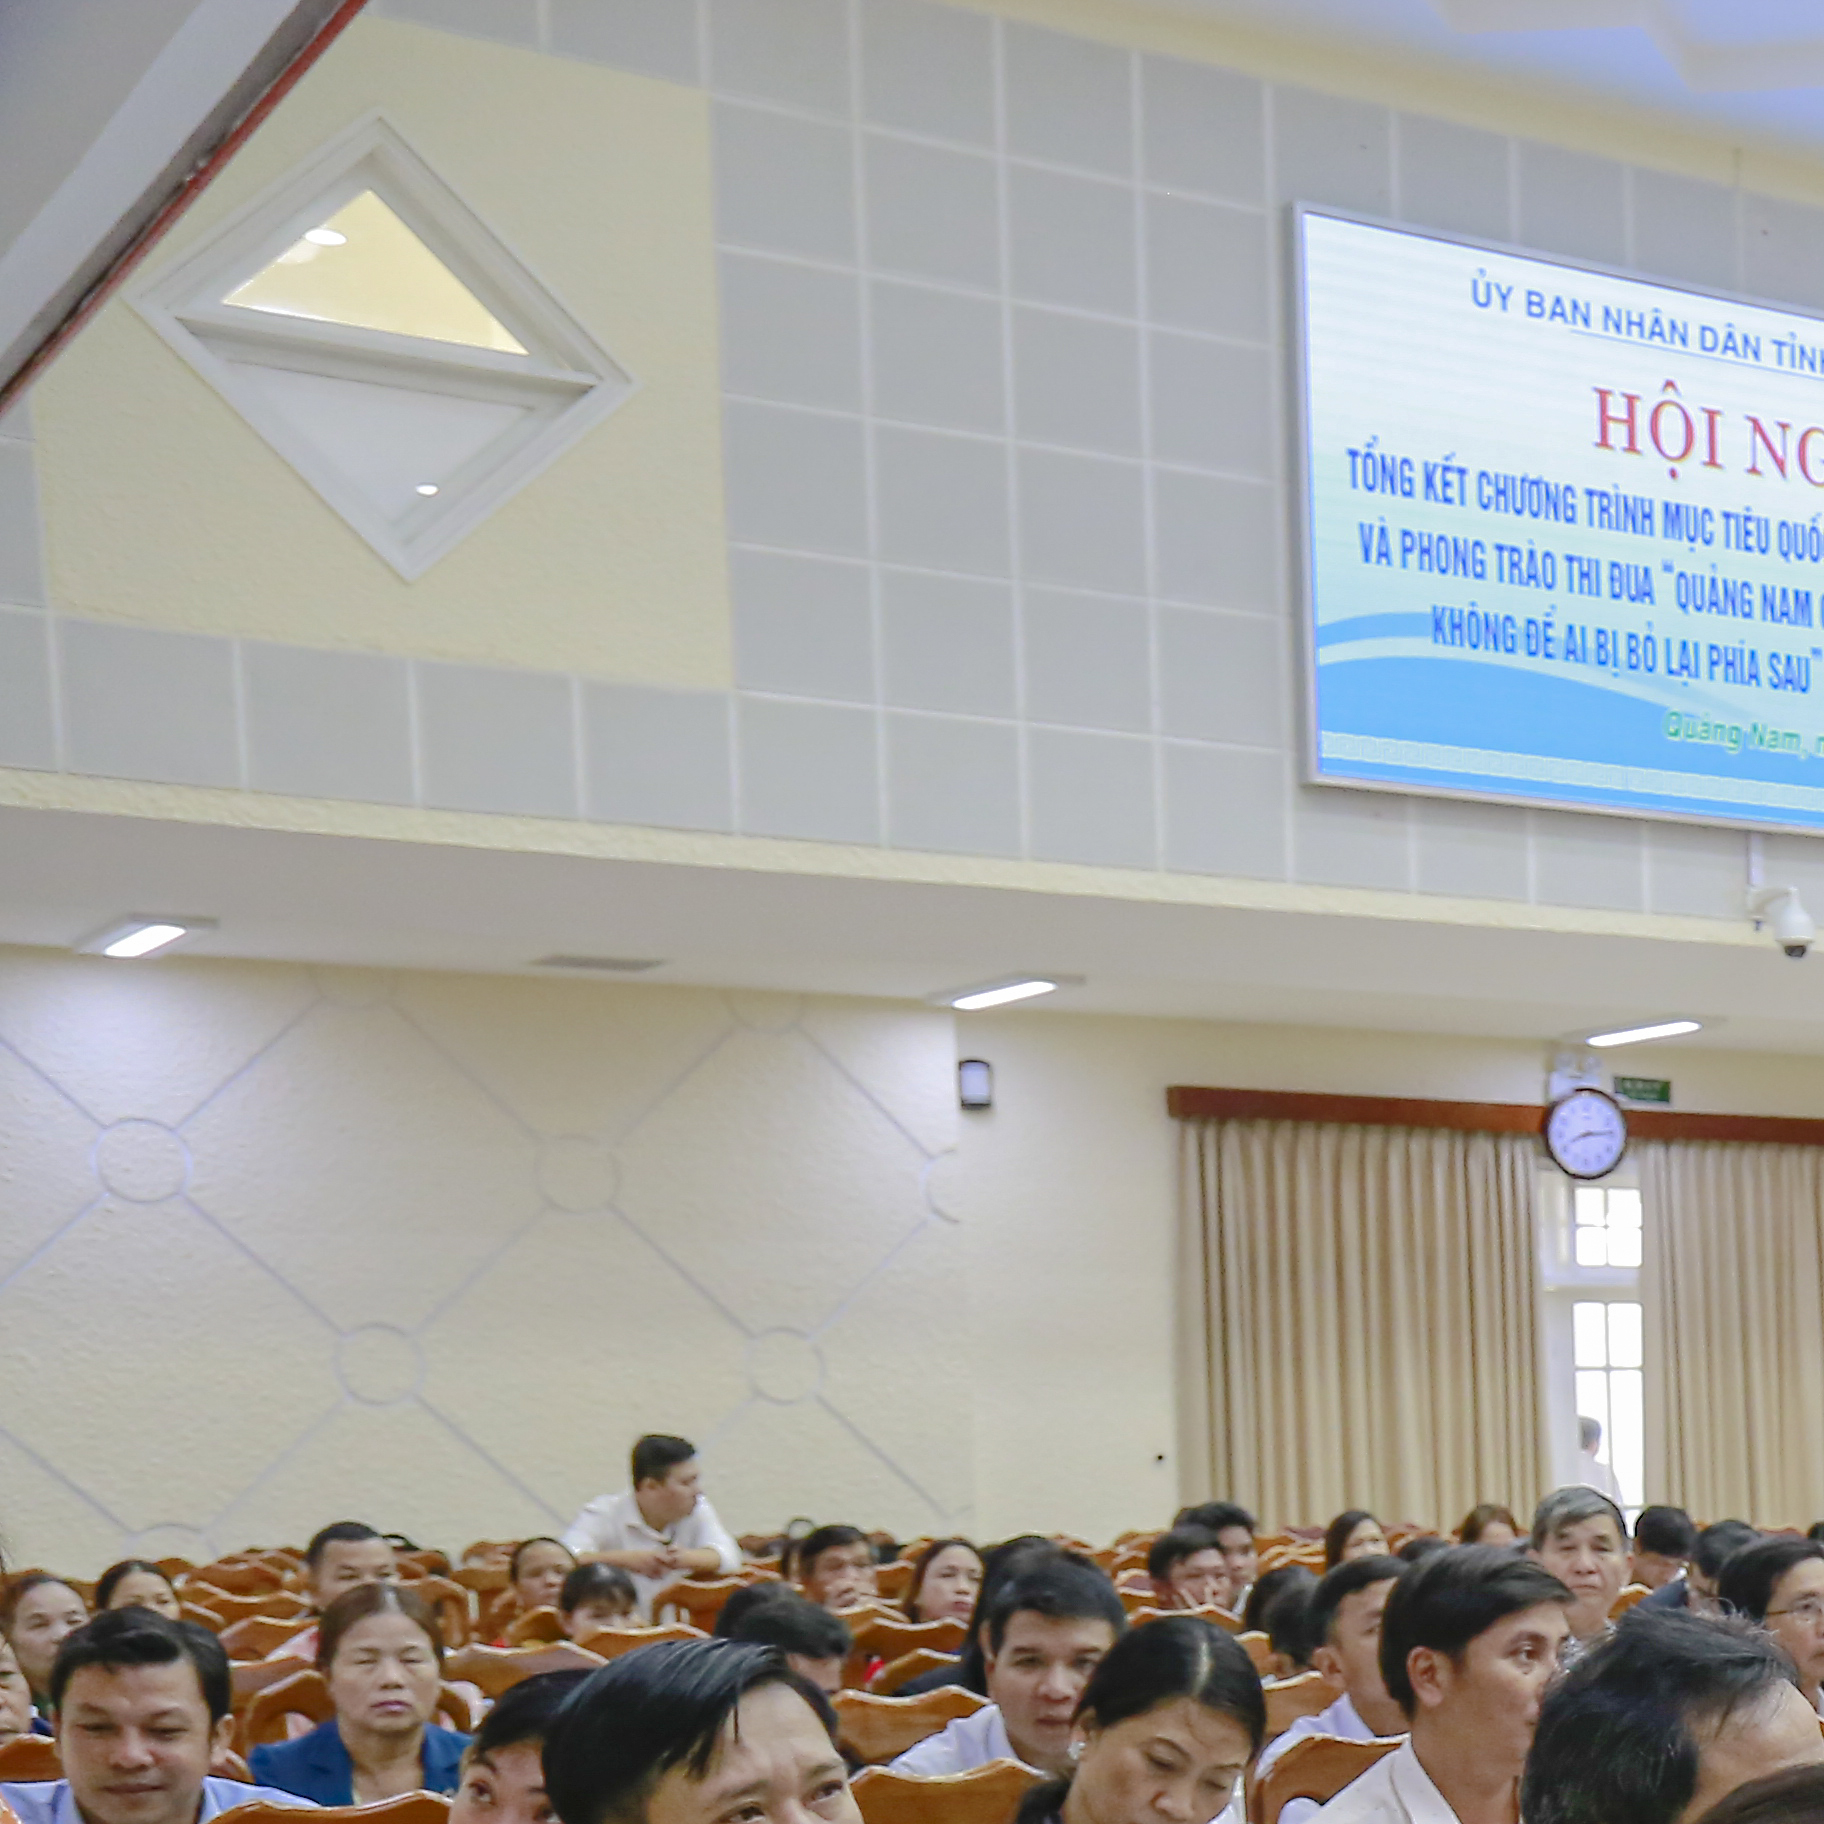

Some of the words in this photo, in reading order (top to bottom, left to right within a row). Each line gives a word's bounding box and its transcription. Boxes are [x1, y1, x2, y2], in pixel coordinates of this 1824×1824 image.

[1471, 267, 1514, 312] ỦY
[1525, 289, 1591, 329] BAN
[1603, 305, 1688, 349] NHÂN
[1700, 322, 1761, 362] DÂN
[1593, 379, 1723, 480] HỘI
[1346, 434, 1415, 499] TỔNG
[1423, 452, 1468, 506] KẾT
[1477, 470, 1577, 525] CHƯƠNG
[1585, 483, 1655, 537] TRÌNH
[1662, 500, 1715, 553] MỤC
[1722, 506, 1770, 556] TIÊU
[1359, 515, 1393, 566] VÀ
[1400, 528, 1486, 580] PHONG
[1494, 539, 1556, 591] TRÀO
[1564, 553, 1601, 597] THI
[1609, 561, 1655, 605] ĐUA
[1761, 583, 1812, 628] NAM
[1432, 601, 1519, 656] KHÔNG
[1525, 604, 1557, 660] ĐỂ
[1564, 623, 1588, 664] AI
[1596, 628, 1619, 678] BỊ
[1626, 621, 1657, 673] BỎ
[1665, 636, 1700, 686] LẠI
[1708, 640, 1761, 687] PHÍA
[1662, 710, 1742, 753] Quảng
[1749, 722, 1807, 759] Nam,
